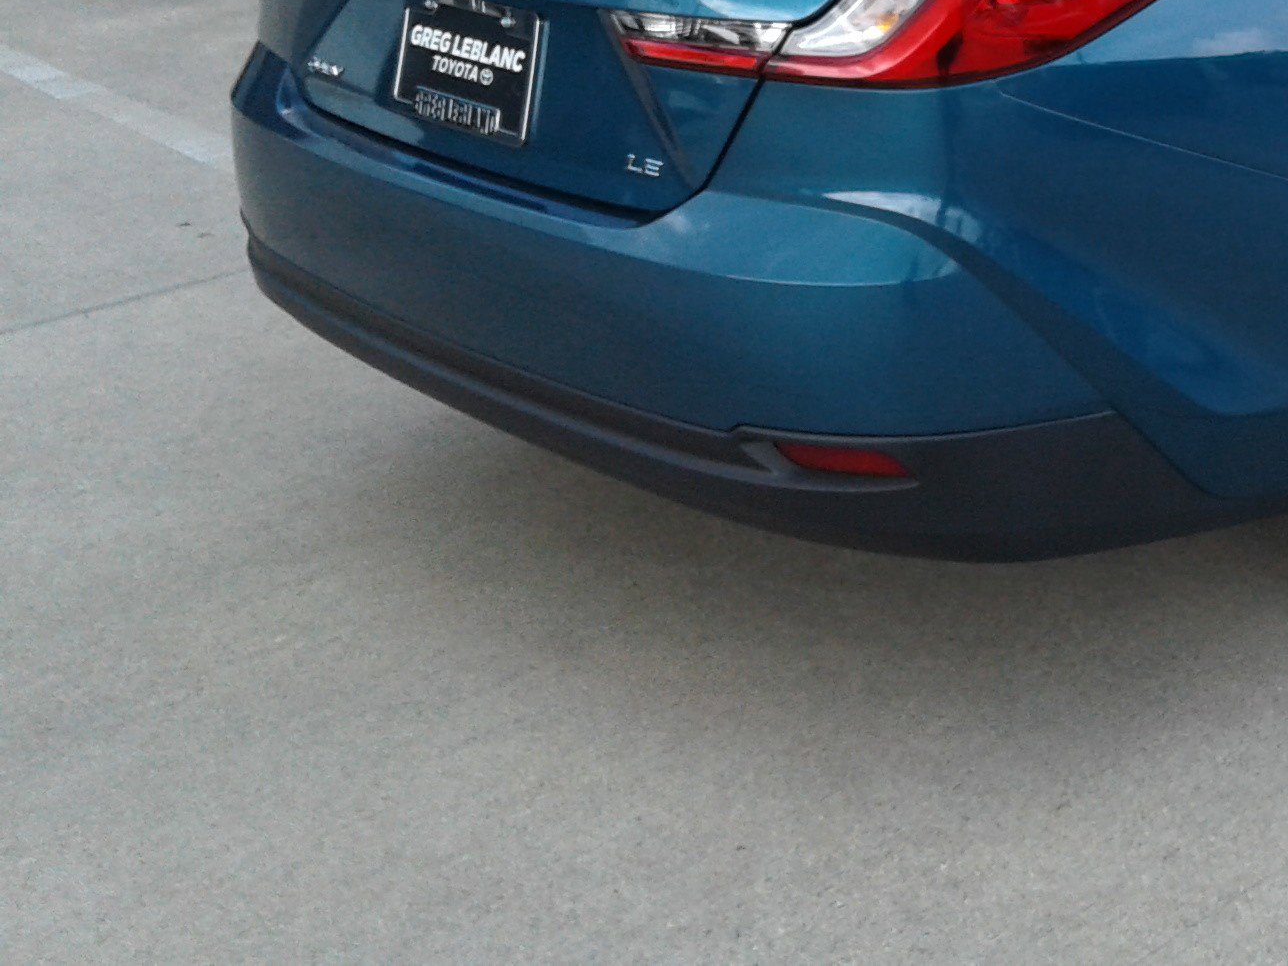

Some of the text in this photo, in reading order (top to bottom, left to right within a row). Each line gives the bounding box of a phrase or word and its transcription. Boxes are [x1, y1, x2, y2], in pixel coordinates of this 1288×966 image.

[410, 24, 526, 73] GREG LEBLANC
[431, 55, 479, 83] TOYOTA
[624, 153, 665, 177] LE
